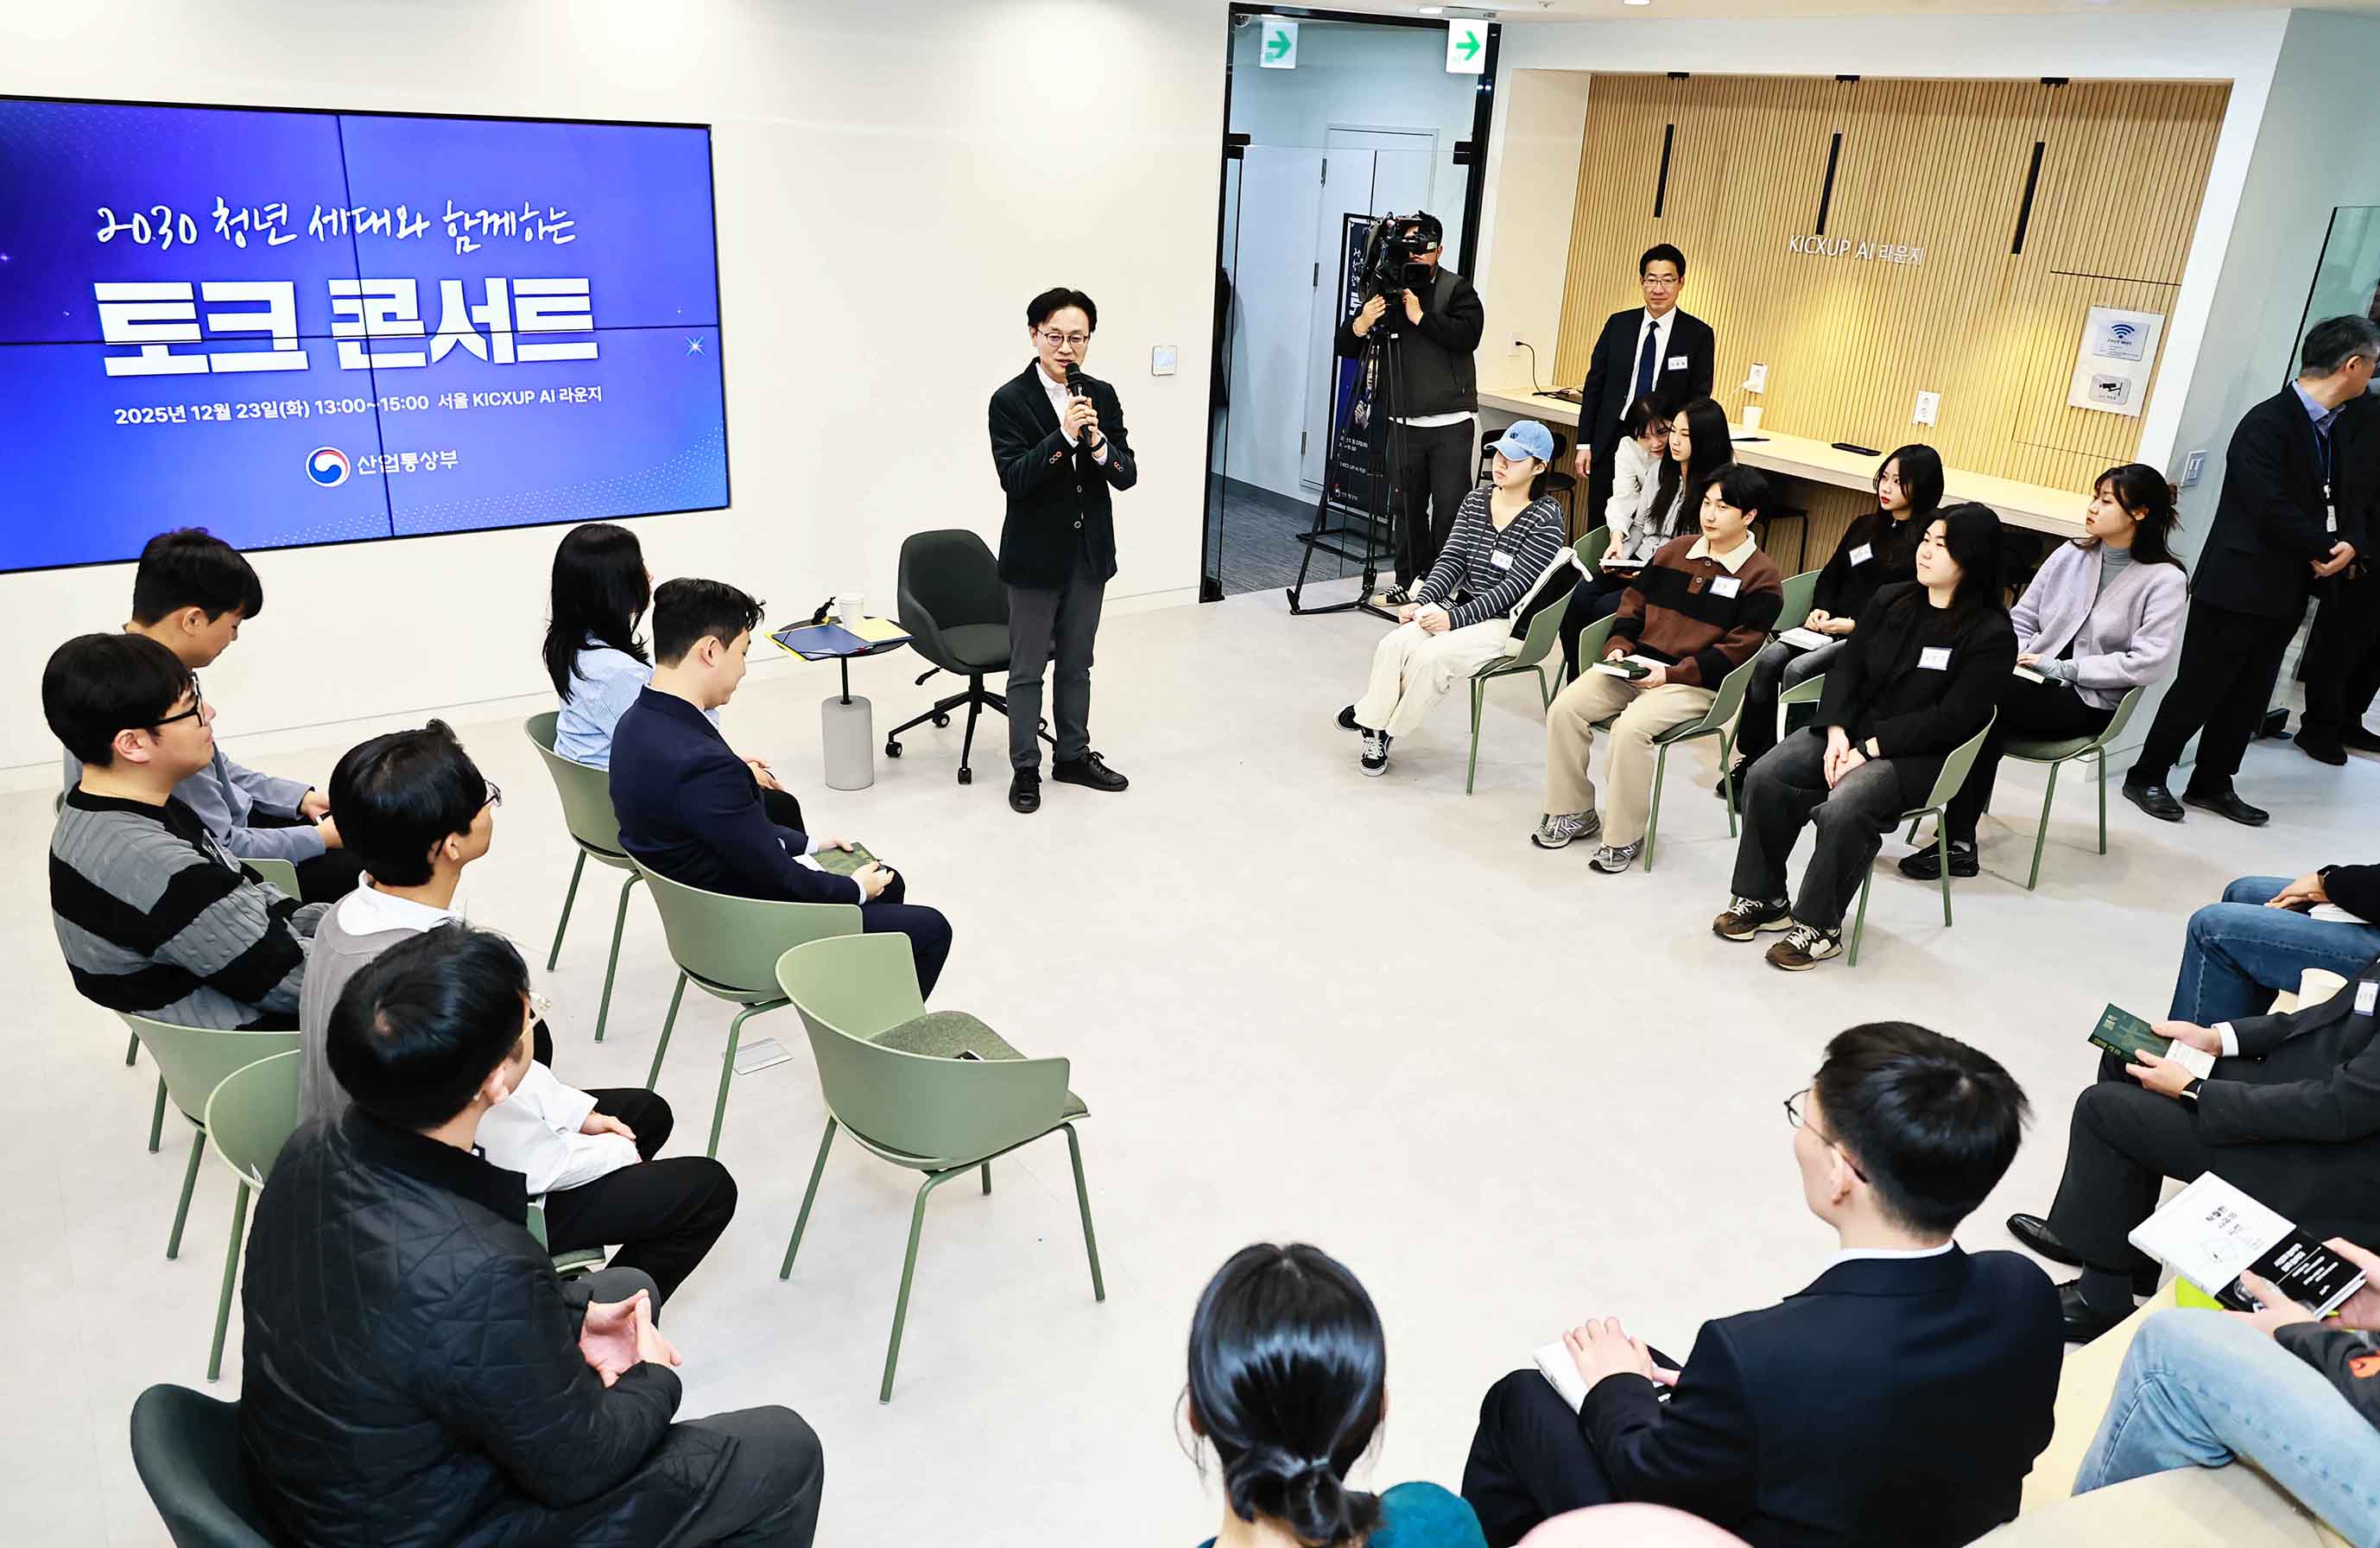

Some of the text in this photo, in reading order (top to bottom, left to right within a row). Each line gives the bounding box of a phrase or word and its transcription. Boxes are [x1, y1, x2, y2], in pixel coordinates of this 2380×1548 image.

[97, 196, 576, 255] 2030 청년 세대와 함께하는
[1788, 234, 1925, 266] KICXUP AI 라운지
[93, 277, 599, 377] 토크 콘서트
[114, 385, 602, 425] 2025년 12월 23일(화) 13:00~15:00 서울 KICXUP AI 라운지
[357, 449, 459, 475] 산업통상부
